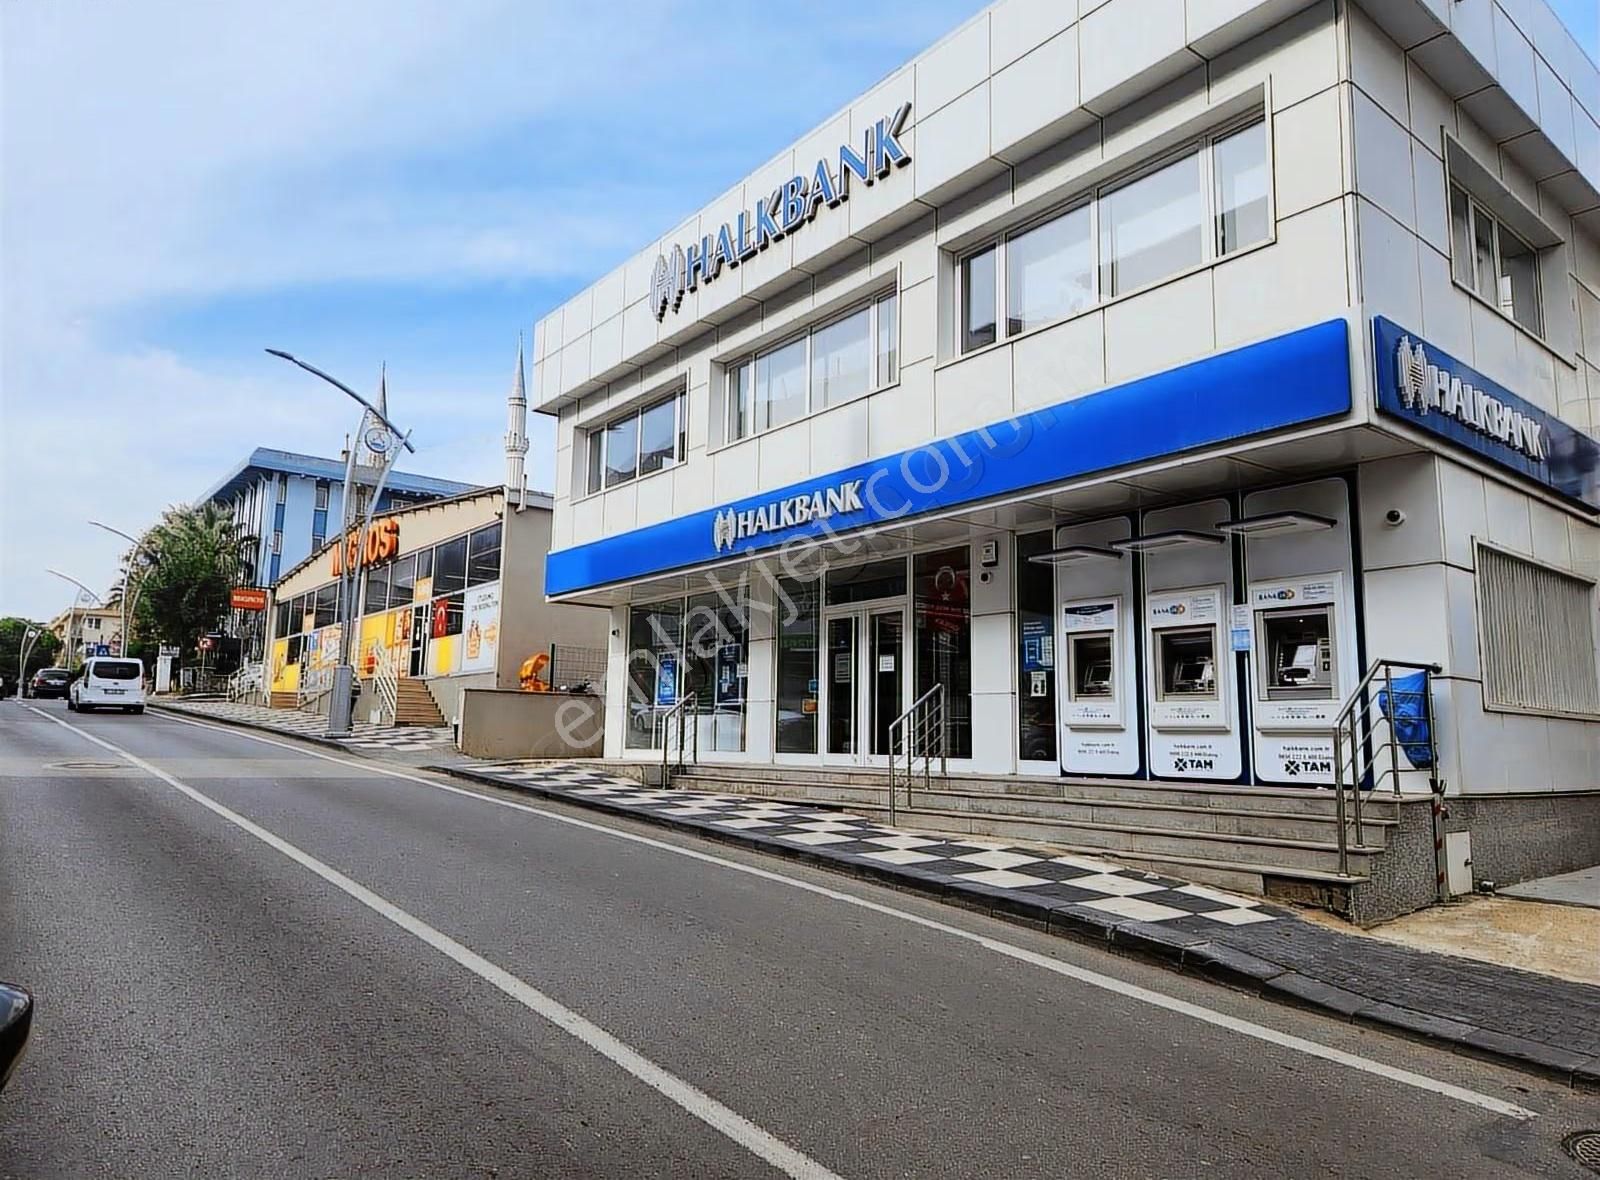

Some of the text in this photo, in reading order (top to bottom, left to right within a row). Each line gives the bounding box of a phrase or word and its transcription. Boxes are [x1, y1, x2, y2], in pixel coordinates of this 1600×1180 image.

[686, 102, 911, 293] HALKBANK
[1427, 364, 1545, 461] HALKBANK
[737, 479, 864, 538] HALKBANK
[1301, 761, 1331, 772] TAM
